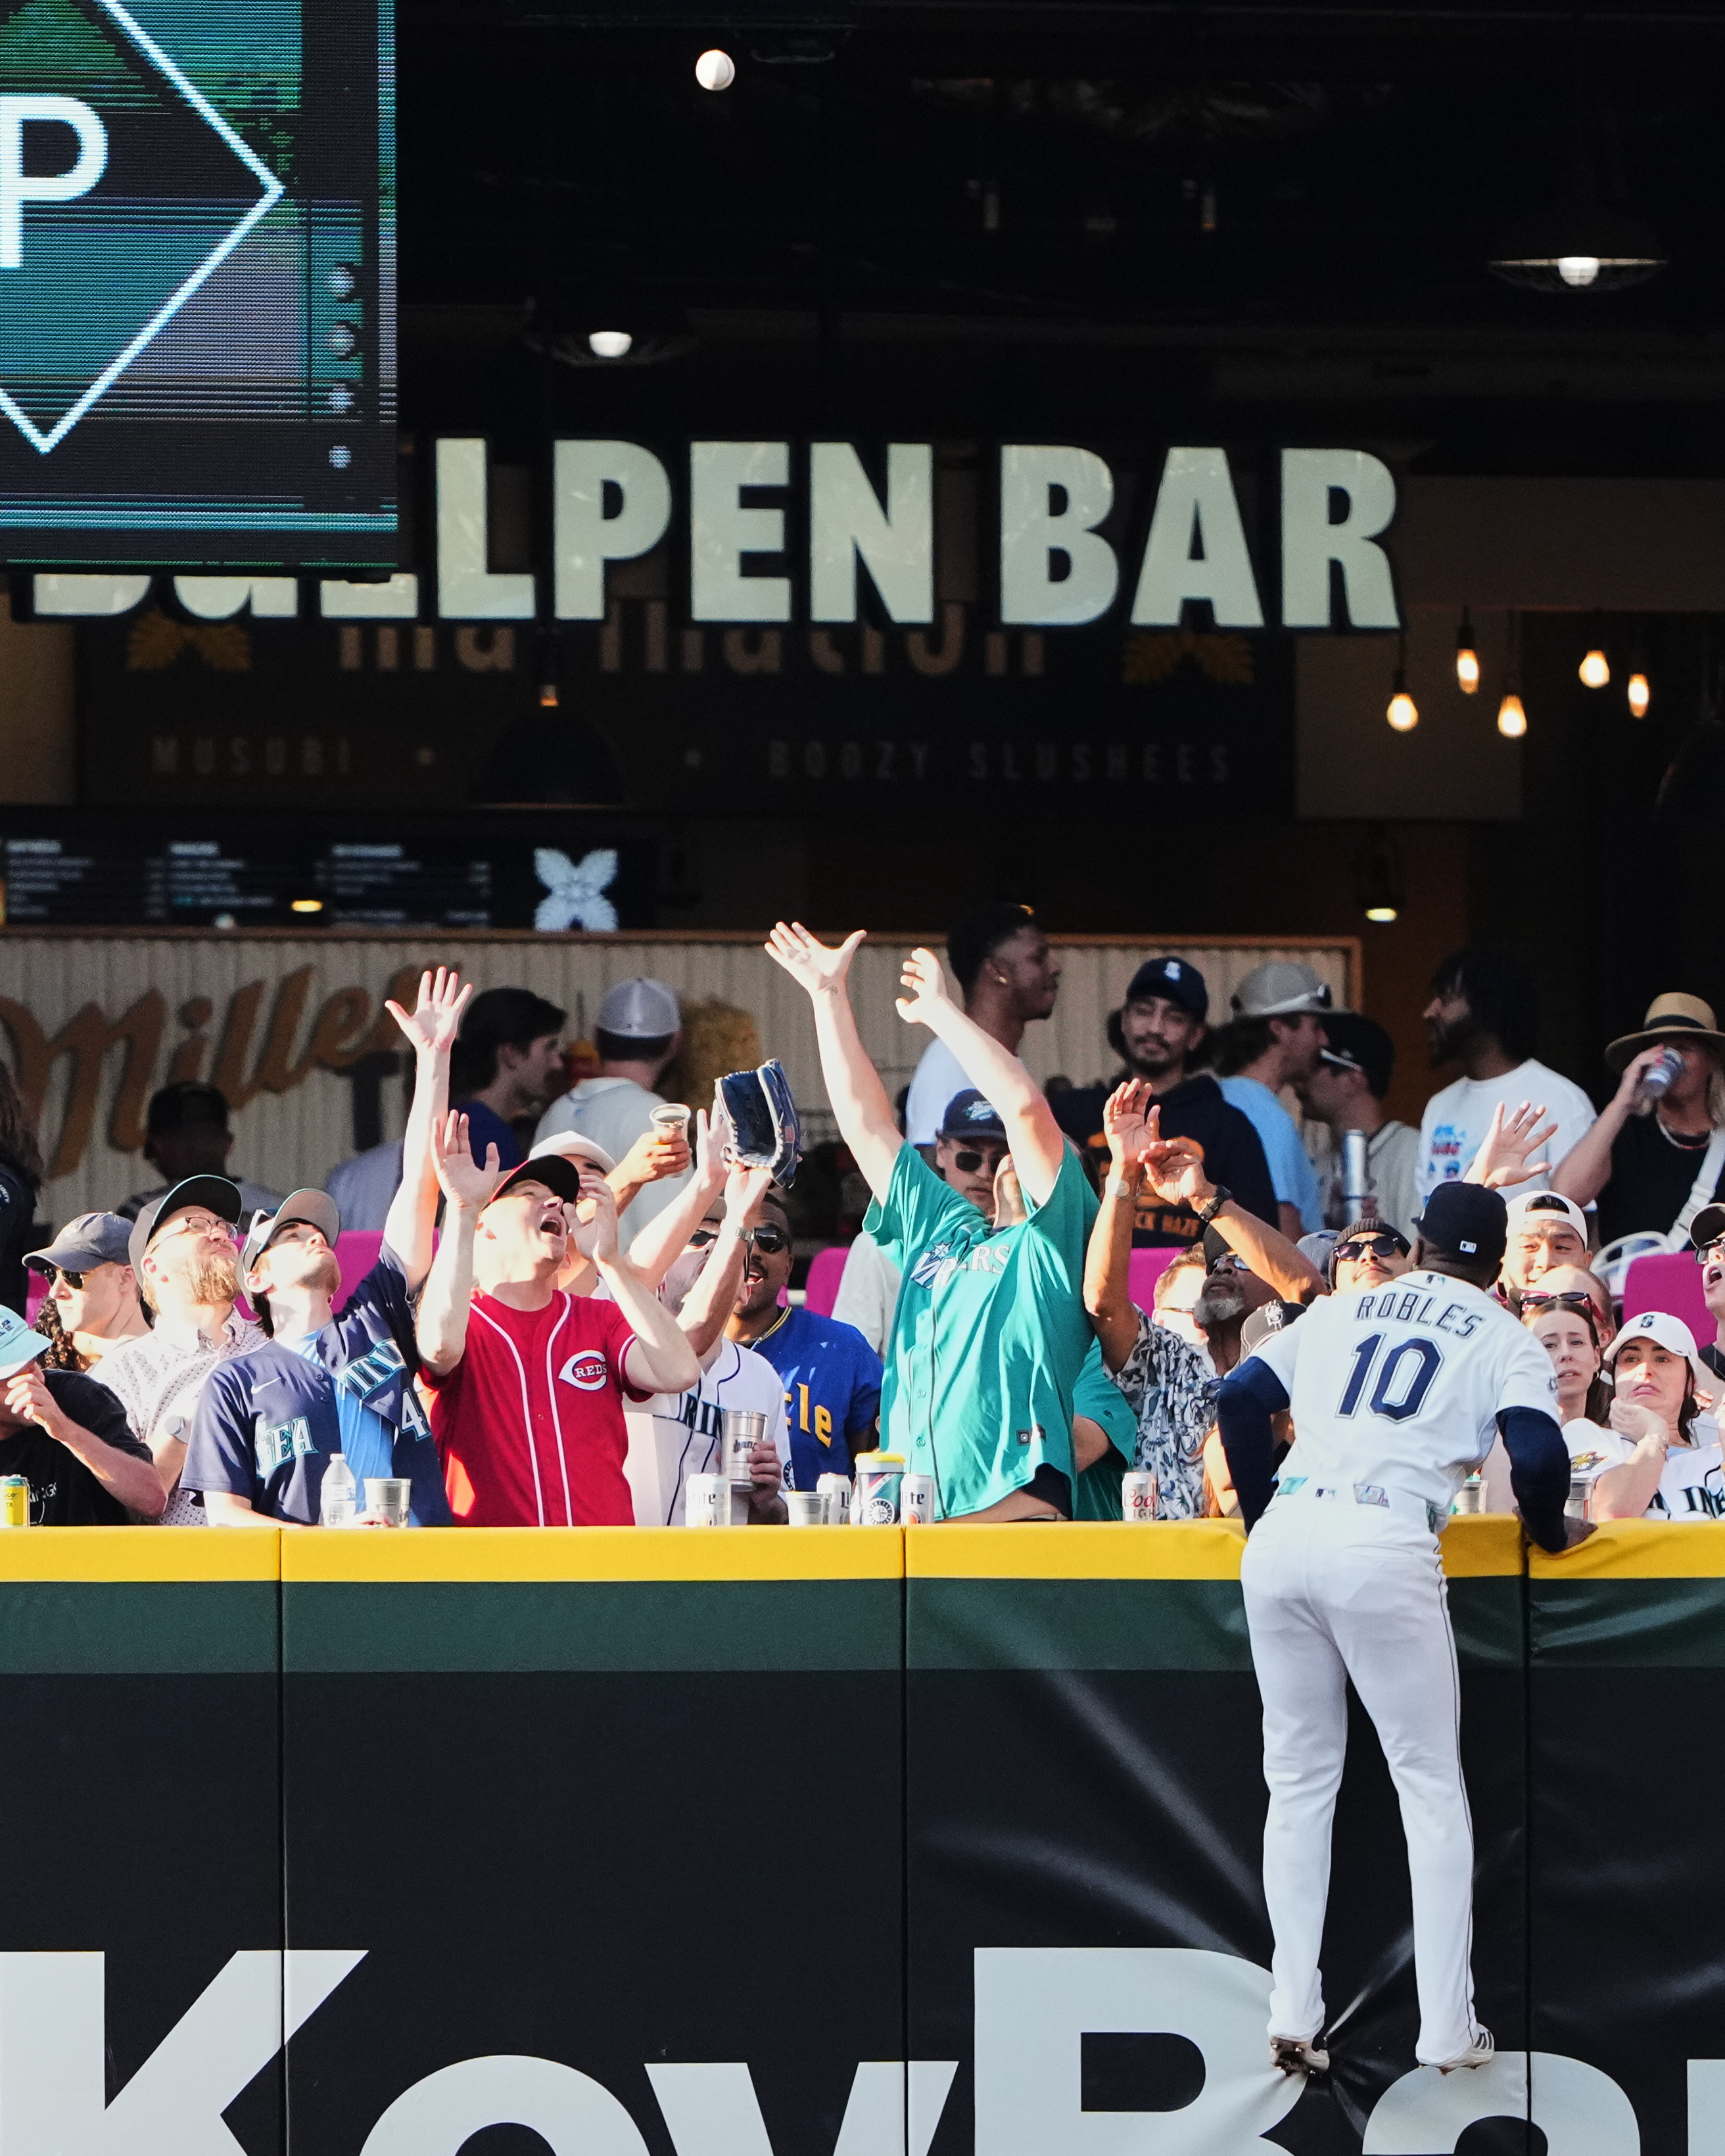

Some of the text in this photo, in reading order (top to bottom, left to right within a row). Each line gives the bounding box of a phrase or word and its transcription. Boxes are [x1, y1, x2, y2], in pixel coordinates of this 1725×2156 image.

[33, 437, 1401, 627] LPEN BAR
[152, 735, 352, 774] MUSUBI
[768, 738, 1232, 785] BOOZY SLUSHEES
[1354, 1293, 1485, 1339] ROBLES
[574, 1364, 607, 1378] REDS
[1335, 1331, 1445, 1425] 10
[784, 1382, 832, 1448] le
